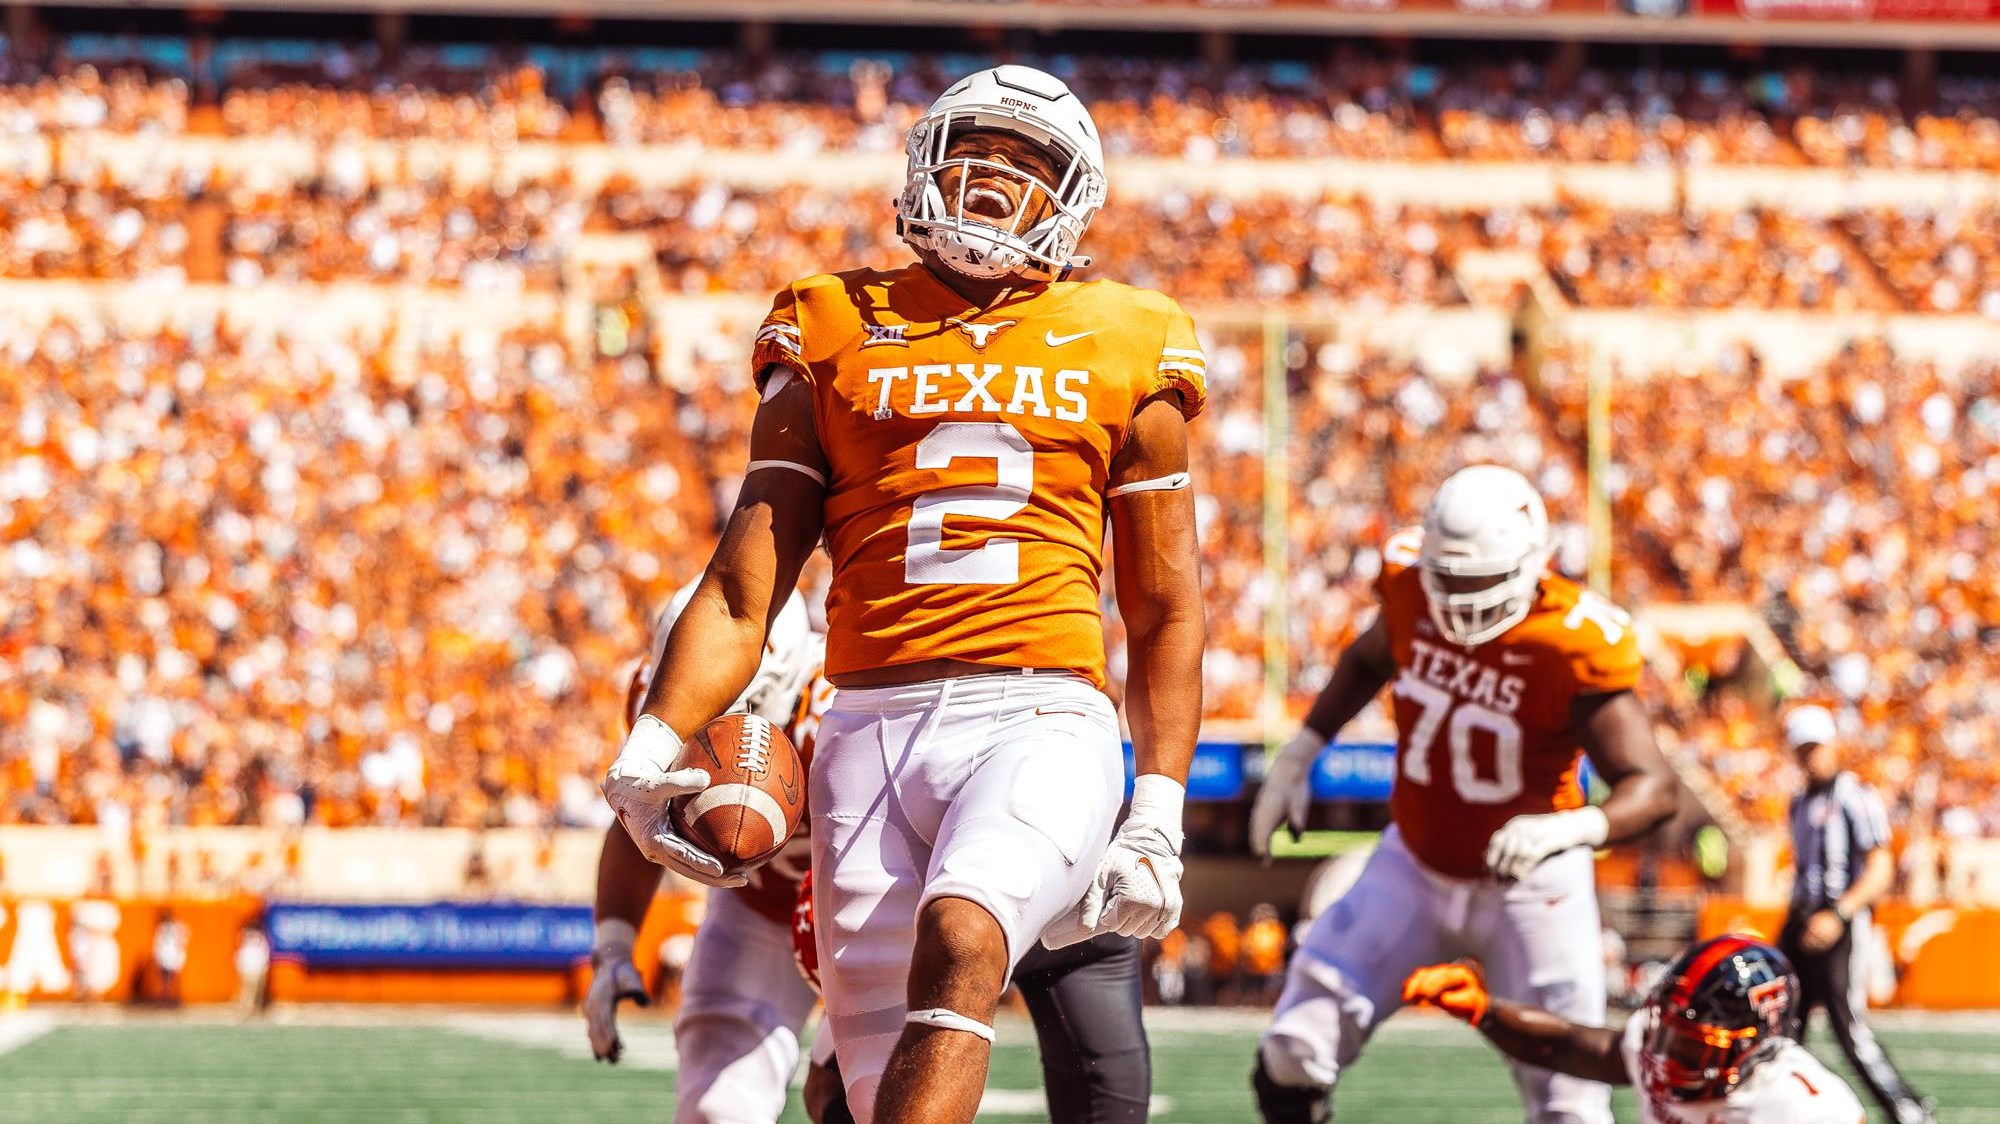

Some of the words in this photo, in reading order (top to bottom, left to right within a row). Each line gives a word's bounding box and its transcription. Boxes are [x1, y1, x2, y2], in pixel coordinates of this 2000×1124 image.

[1000, 96, 1038, 112] HORNS
[867, 363, 1089, 424] TEXAS
[904, 422, 1034, 585] 2
[1410, 639, 1526, 713] TEXAS
[1393, 668, 1525, 804] 70
[0, 900, 121, 993] AS
